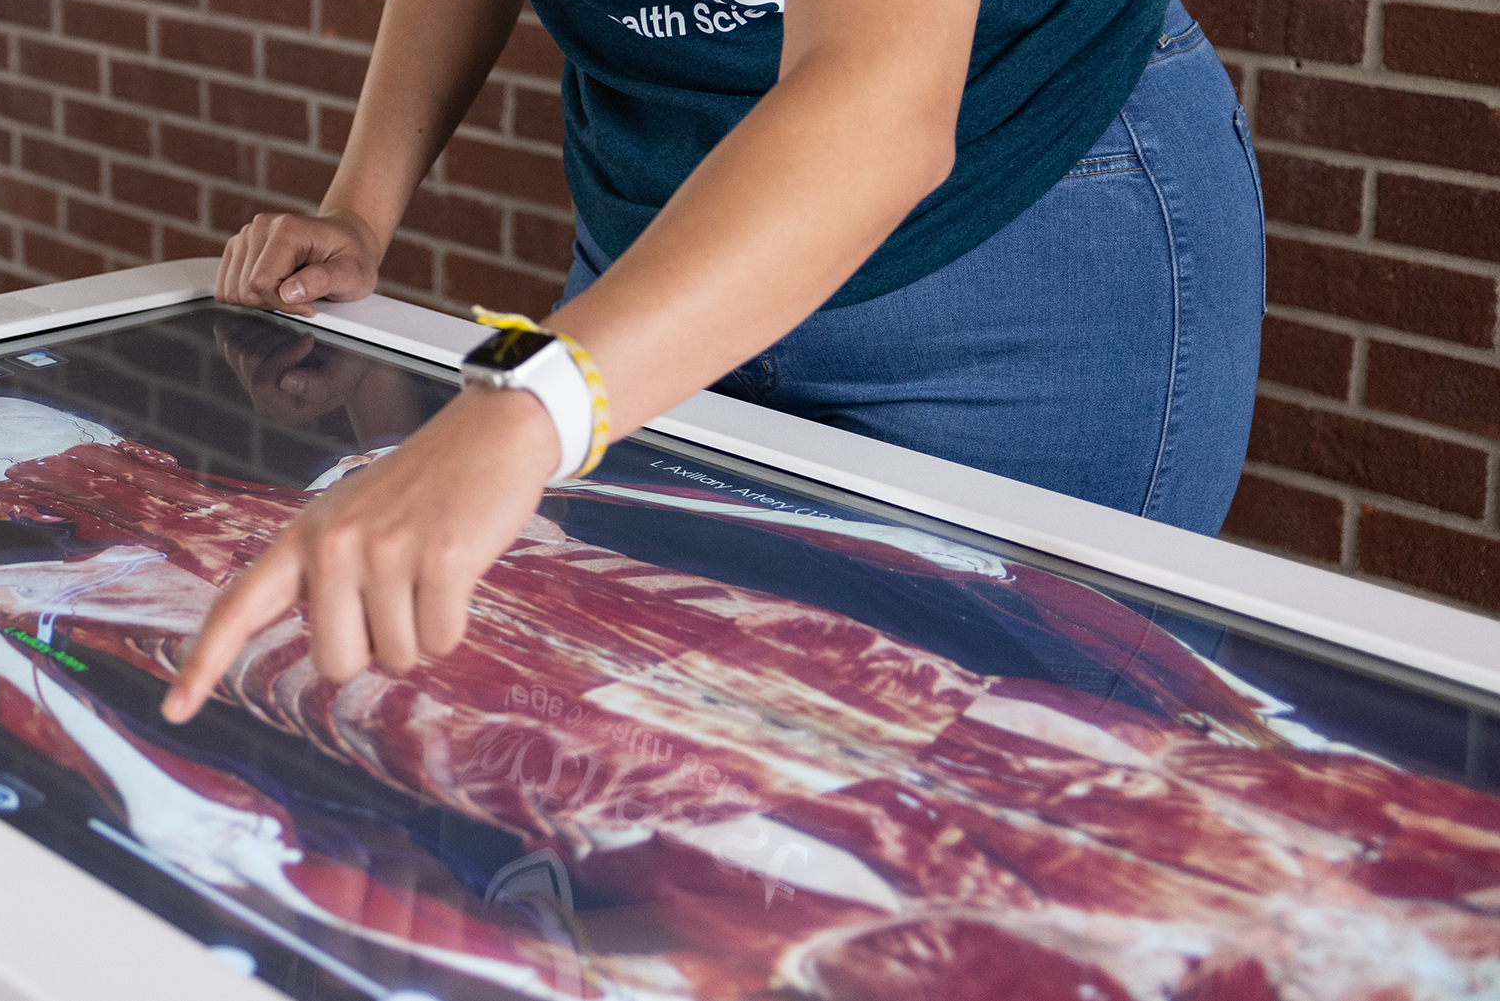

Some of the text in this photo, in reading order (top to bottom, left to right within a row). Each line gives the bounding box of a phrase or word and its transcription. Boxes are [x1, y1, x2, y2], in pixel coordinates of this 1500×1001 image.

[650, 460, 664, 468] L
[663, 464, 733, 491] Axillary
[730, 487, 795, 511] Artery
